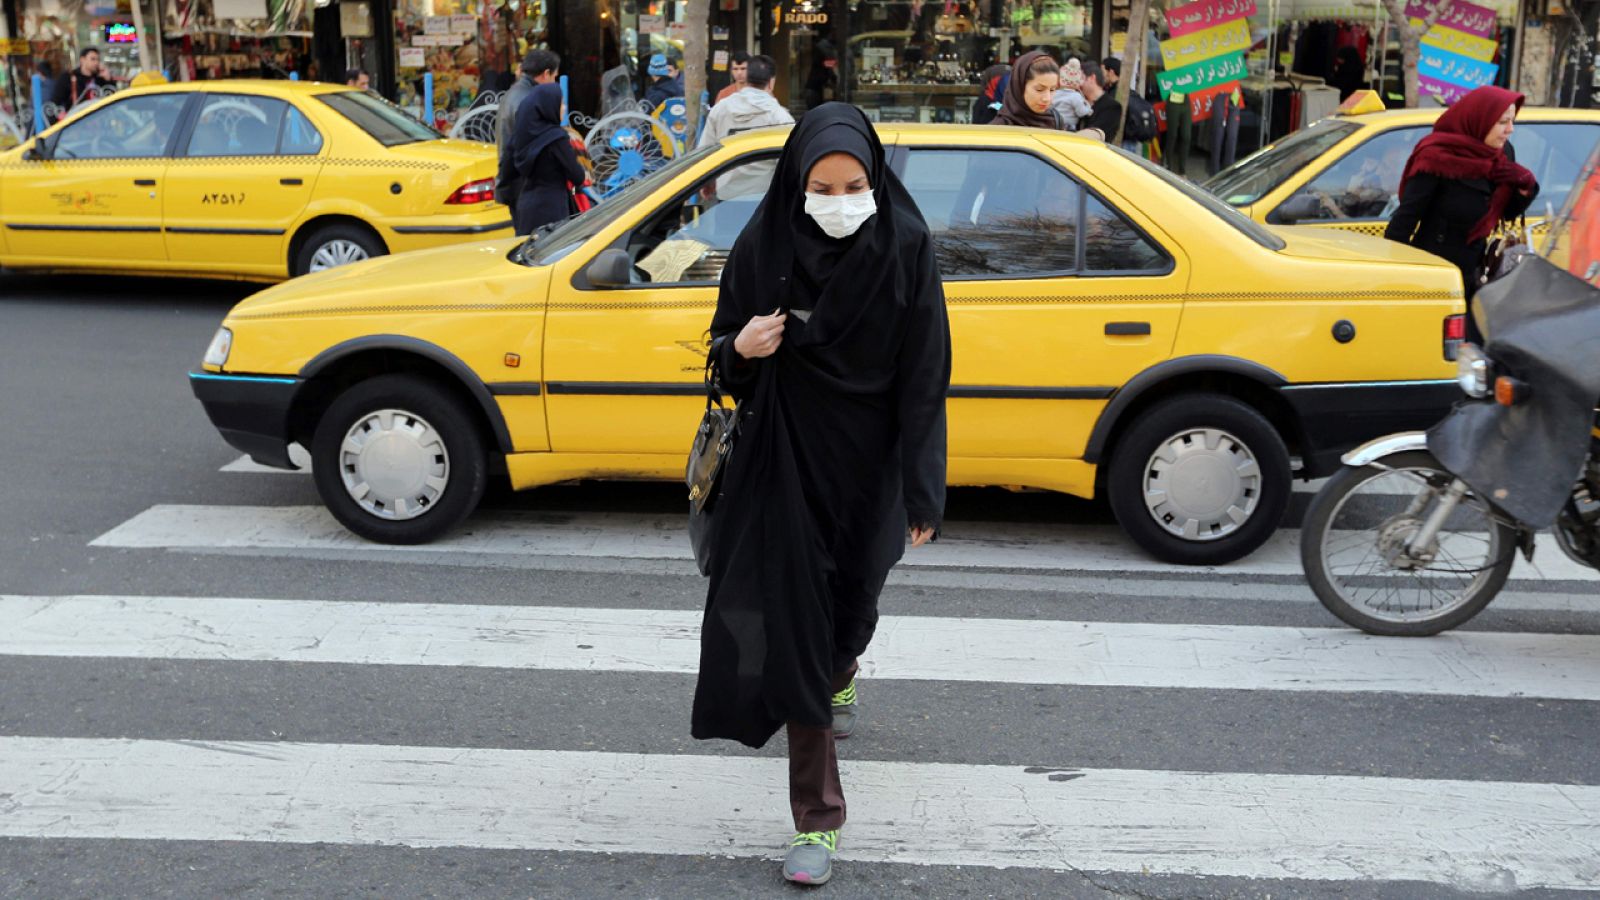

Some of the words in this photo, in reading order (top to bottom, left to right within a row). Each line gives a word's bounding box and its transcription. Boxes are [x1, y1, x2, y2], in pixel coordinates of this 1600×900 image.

[785, 13, 828, 24] RADO
[1217, 56, 1243, 78] ارزان
[1175, 74, 1193, 86] همه
